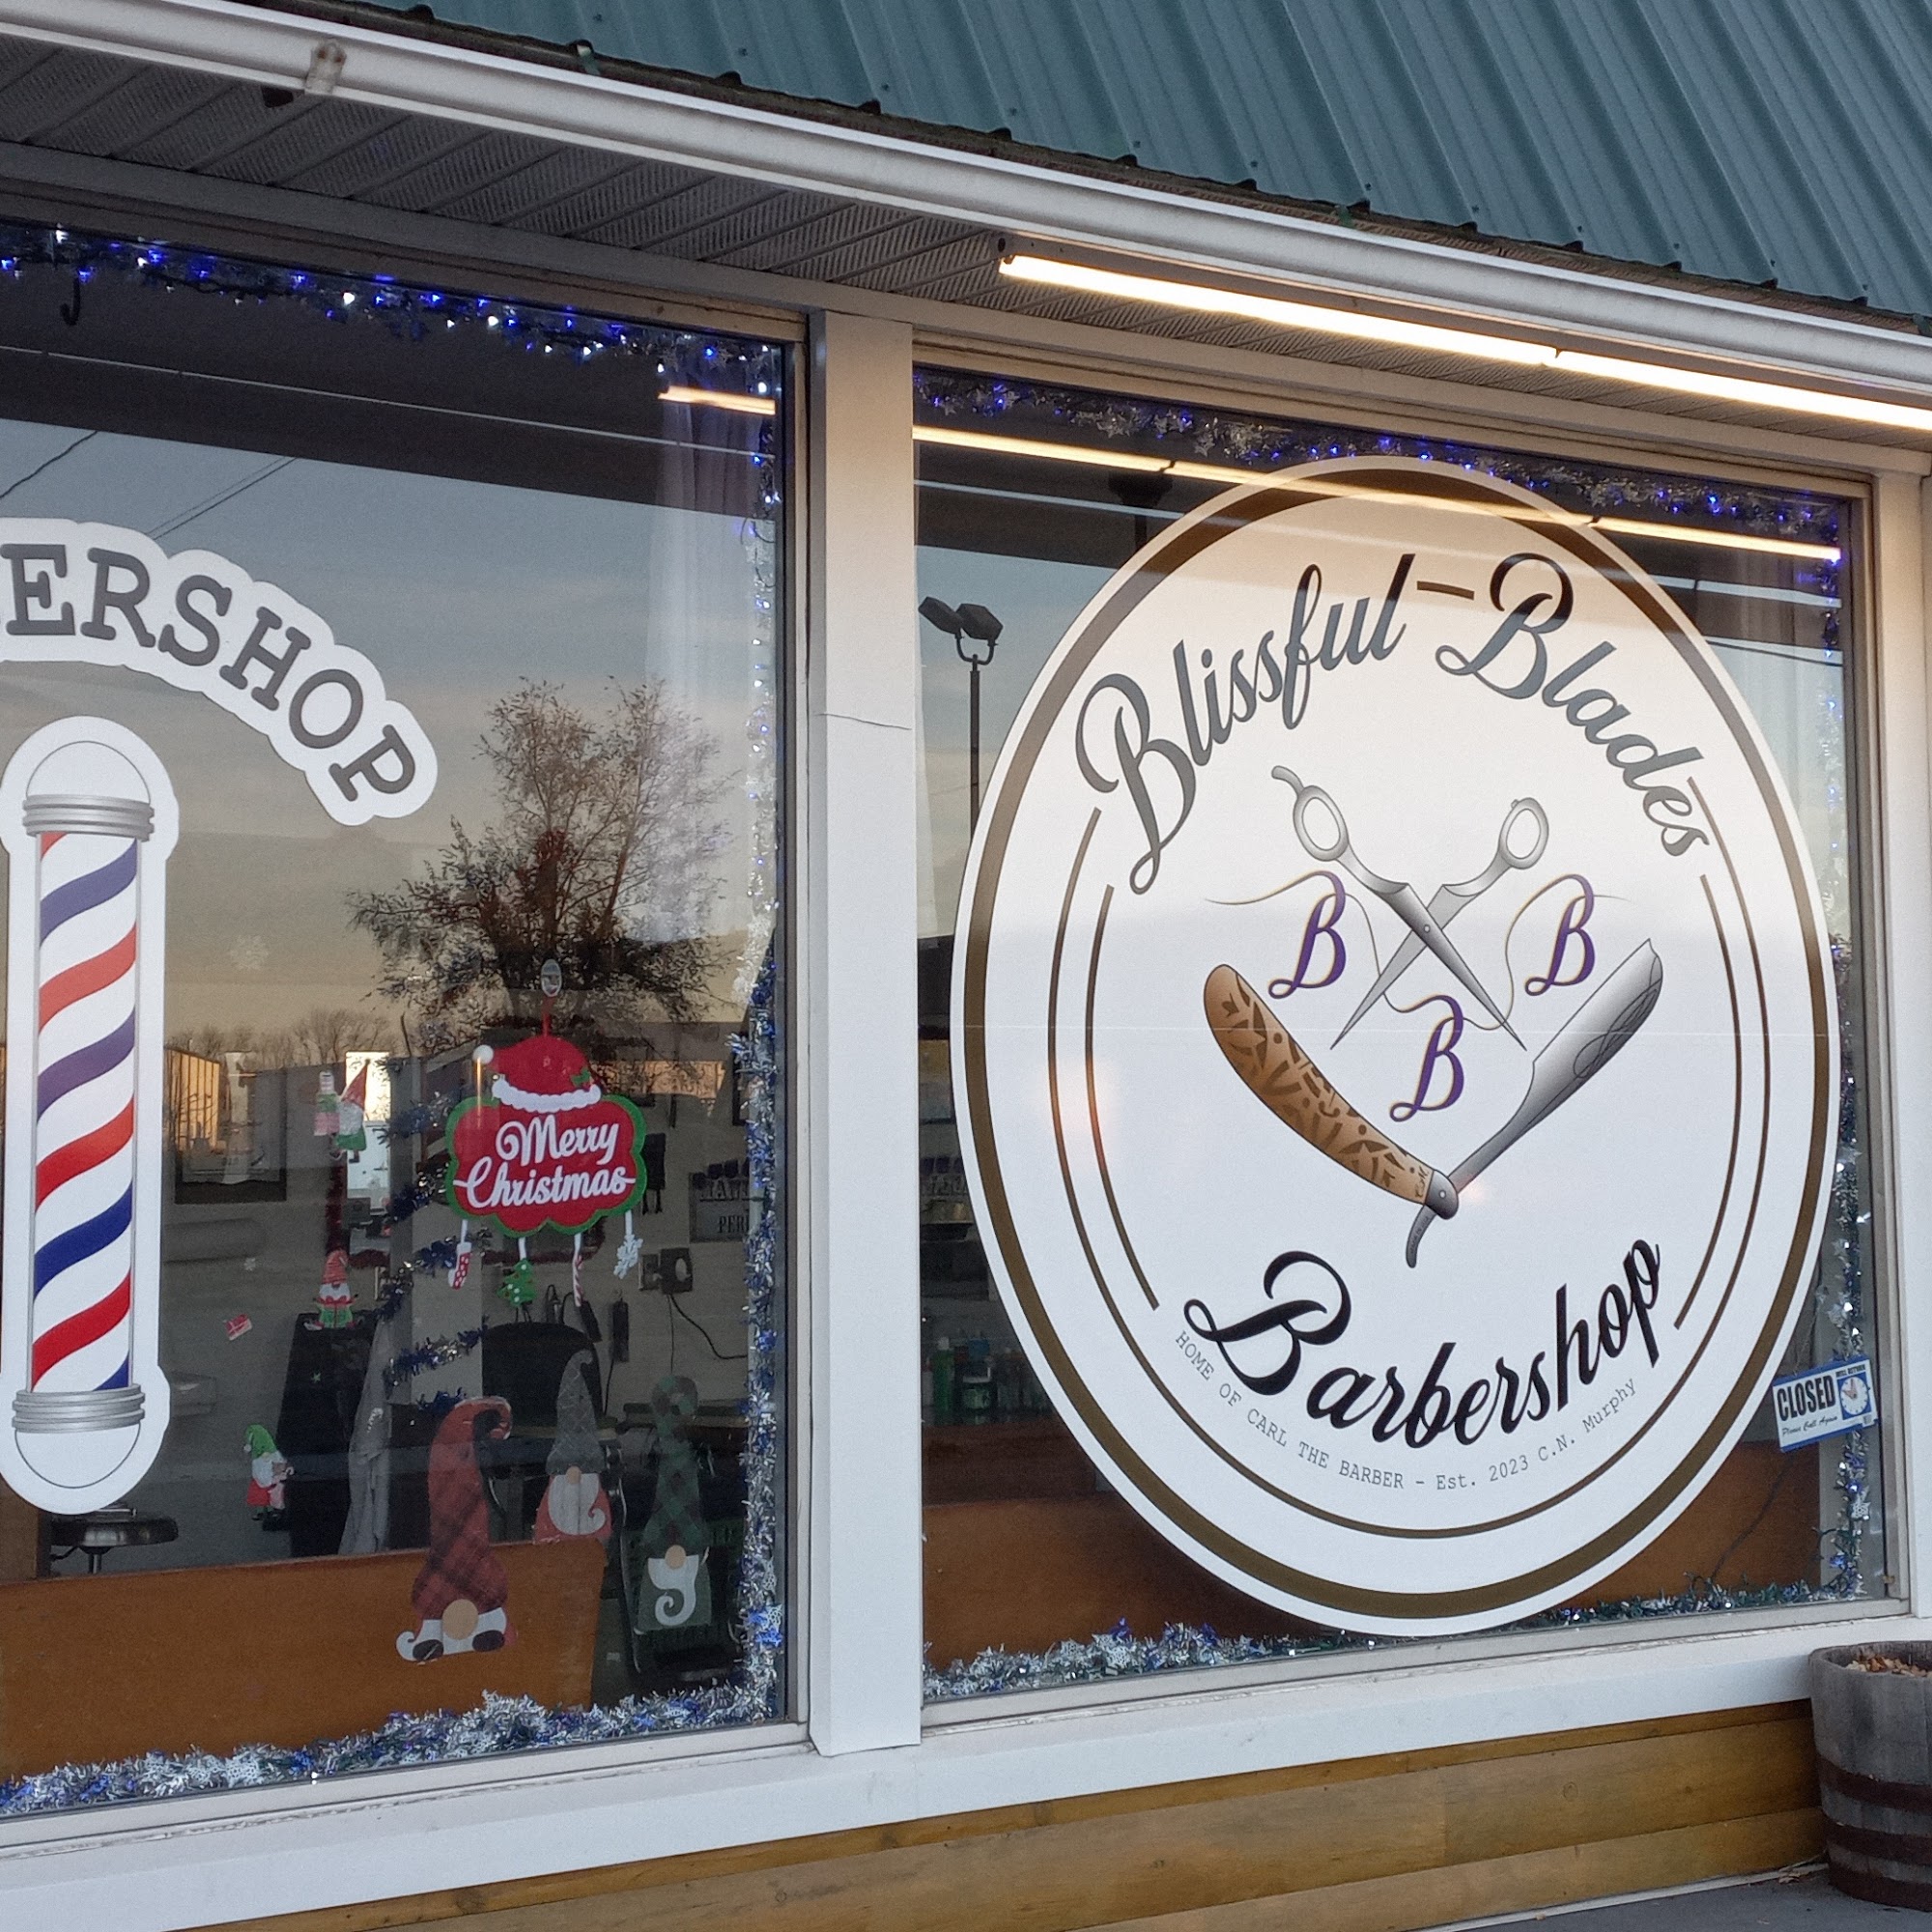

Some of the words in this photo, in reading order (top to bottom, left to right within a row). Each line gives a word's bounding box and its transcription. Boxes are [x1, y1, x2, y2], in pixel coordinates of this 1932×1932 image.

[0, 544, 415, 802] ERSHOP
[1268, 870, 1346, 999] B
[1525, 874, 1596, 996] B
[1389, 994, 1464, 1122] B
[453, 1156, 636, 1208] Christmas
[496, 1117, 619, 1167] Merry
[1183, 1239, 1661, 1449] Barbershop
[1776, 1375, 1836, 1422] CLOSED
[1176, 1331, 1214, 1380] HOME
[1219, 1383, 1242, 1406] OF
[1247, 1408, 1288, 1447] CARL
[1298, 1441, 1329, 1468] THE
[1339, 1460, 1404, 1489] BARBER
[1436, 1473, 1476, 1490] Est.
[1489, 1455, 1529, 1482] 2023
[1538, 1435, 1576, 1462] C.N.
[1581, 1378, 1636, 1434] Murphy
